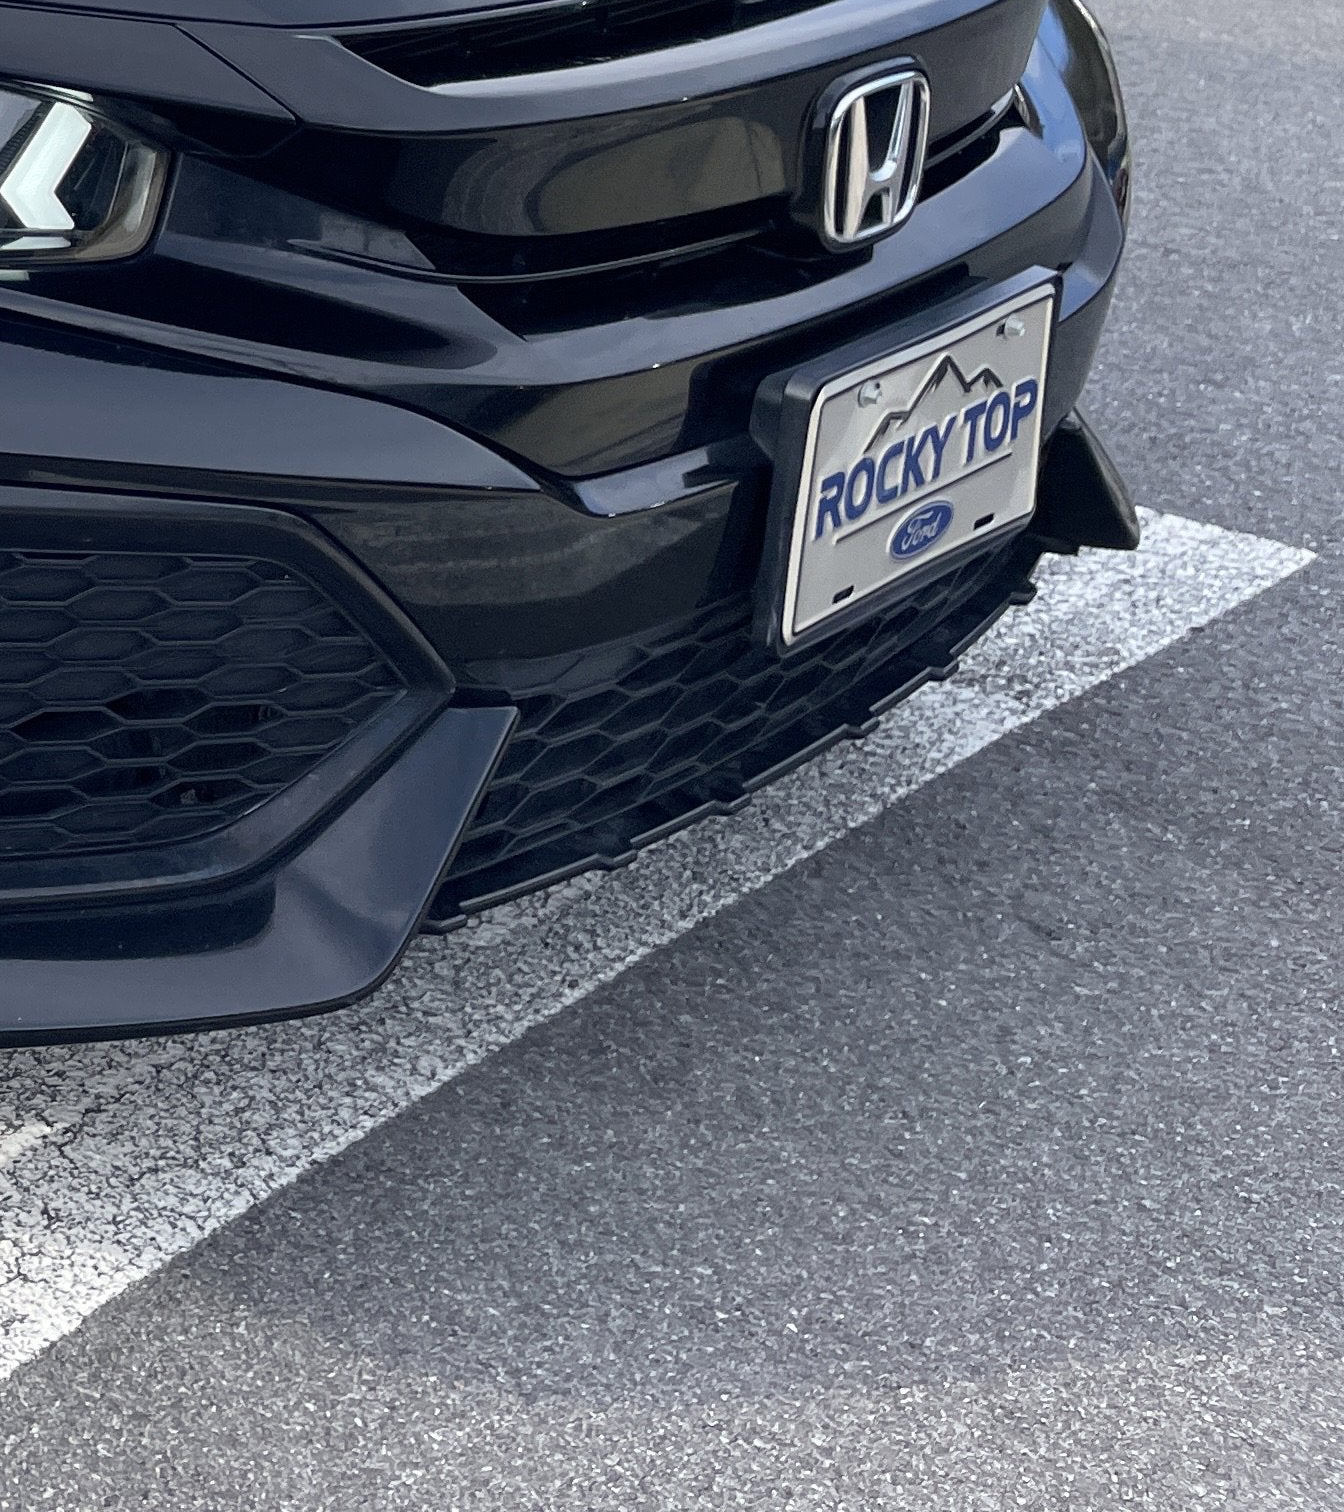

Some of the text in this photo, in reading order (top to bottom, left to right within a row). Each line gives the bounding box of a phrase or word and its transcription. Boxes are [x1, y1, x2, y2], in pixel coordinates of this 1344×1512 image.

[815, 377, 1039, 539] ROCKY TOP
[900, 509, 943, 552] Ford
